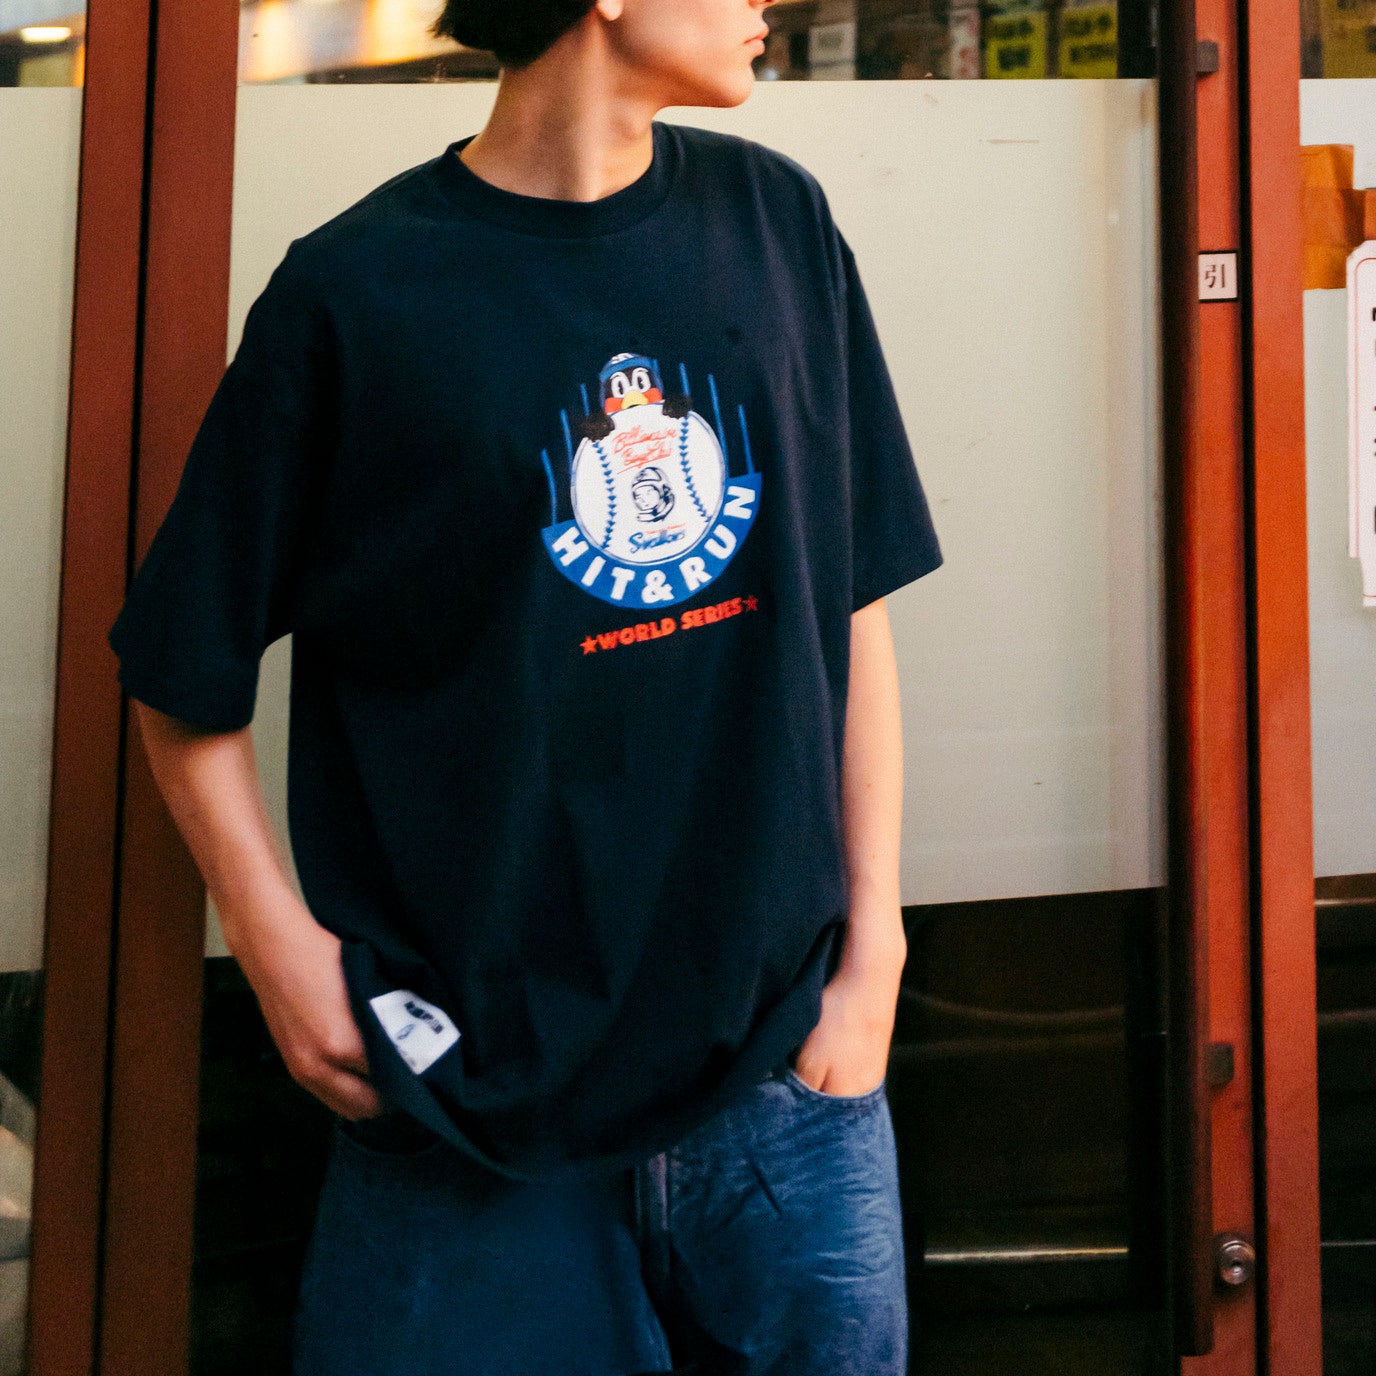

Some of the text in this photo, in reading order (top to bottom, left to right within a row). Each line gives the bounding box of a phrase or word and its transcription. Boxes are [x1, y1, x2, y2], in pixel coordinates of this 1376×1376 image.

[1204, 262, 1227, 290] 引
[597, 596, 744, 650] WORLD SERIES
